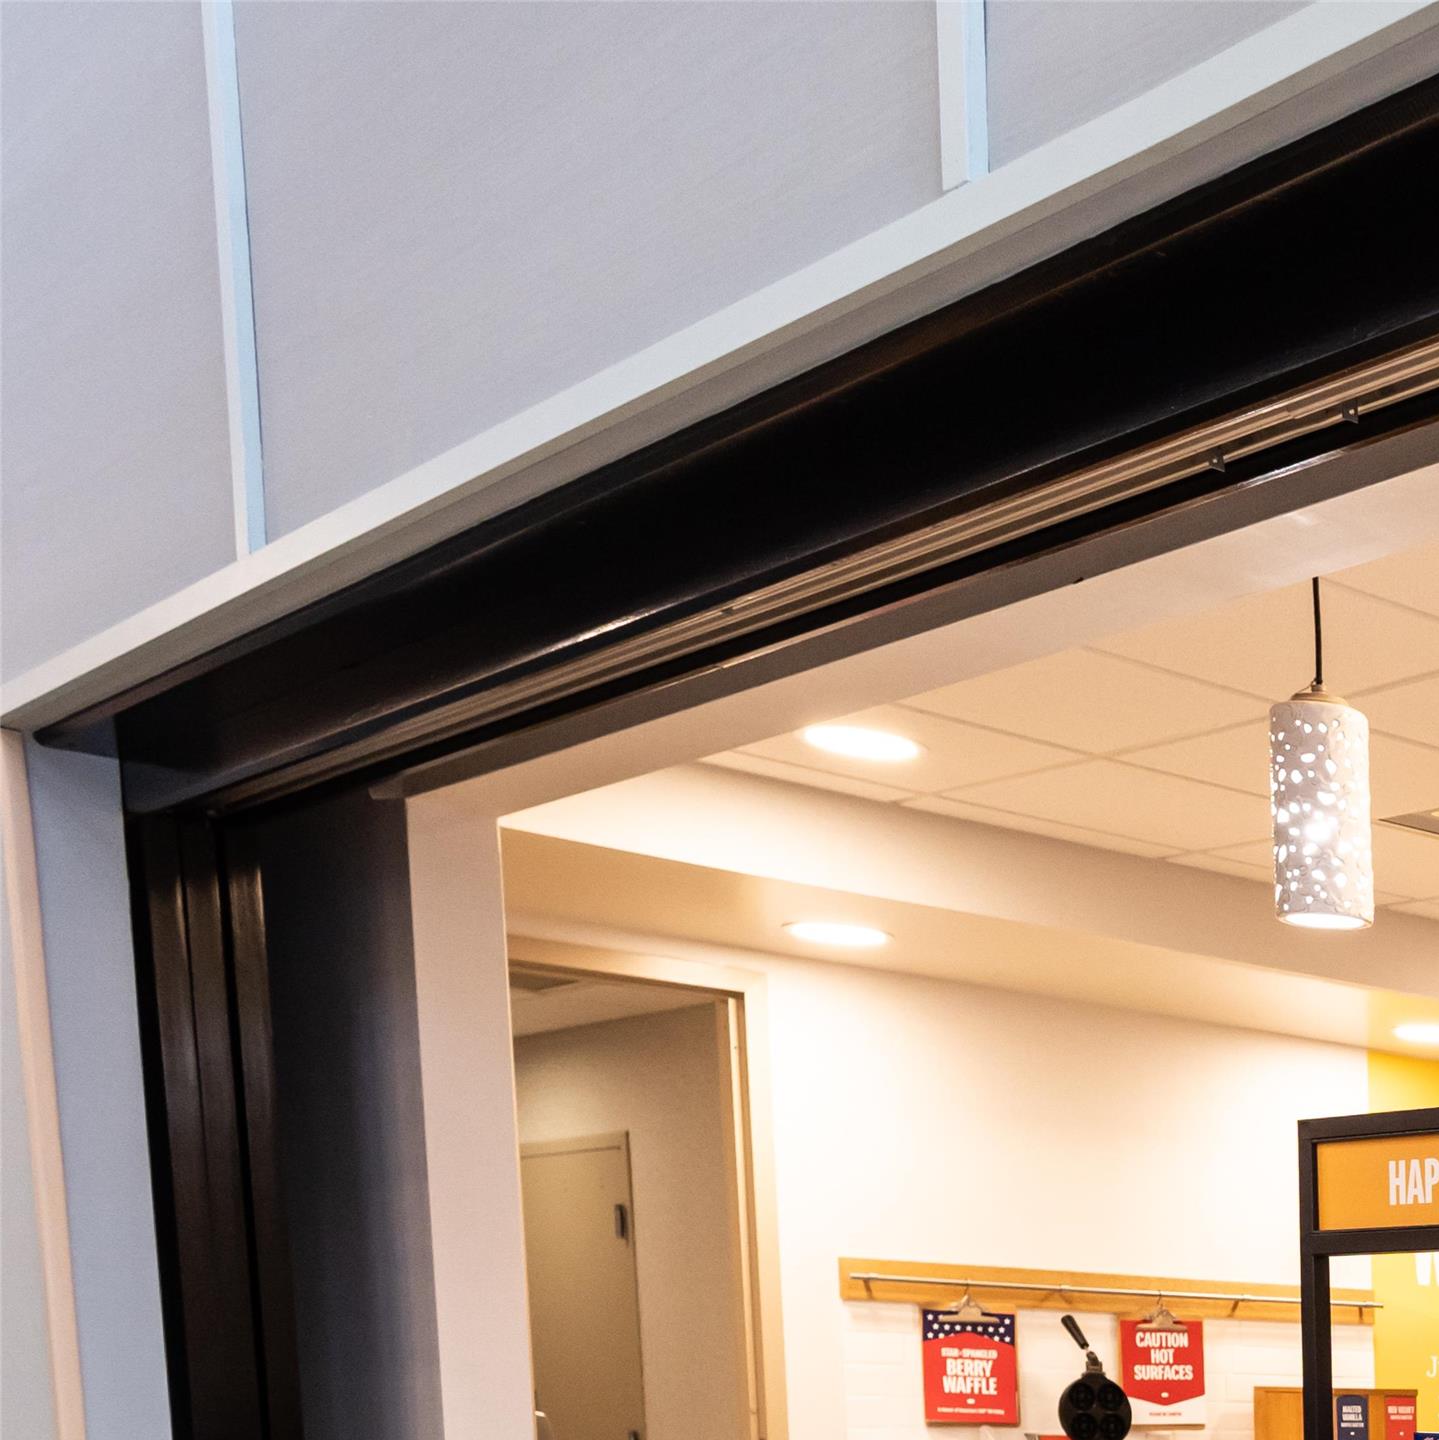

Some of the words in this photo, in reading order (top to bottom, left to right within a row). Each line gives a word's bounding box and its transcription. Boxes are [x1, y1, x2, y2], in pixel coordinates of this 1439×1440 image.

[1135, 1331, 1189, 1349] CAUTION
[1150, 1347, 1175, 1364] HOT
[945, 1358, 993, 1377] BERRY
[1133, 1364, 1194, 1381] SURFACES
[942, 1375, 998, 1396] WAFFLE
